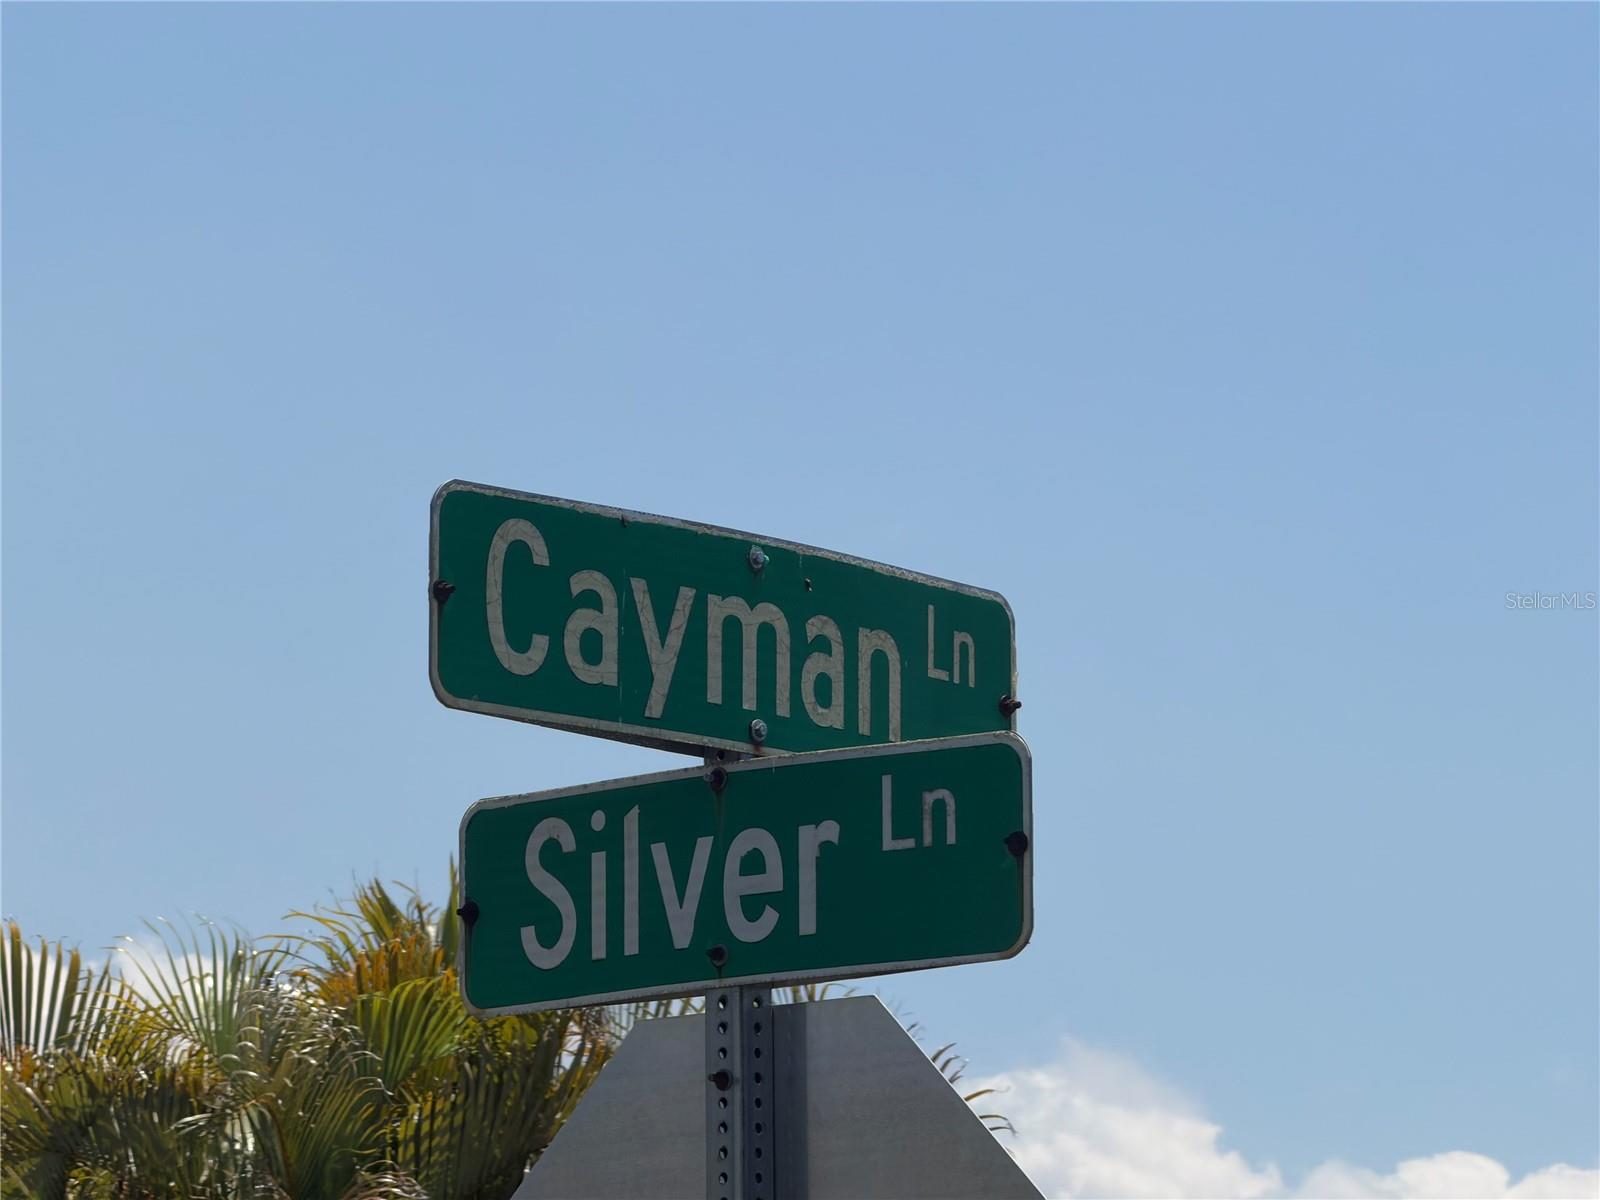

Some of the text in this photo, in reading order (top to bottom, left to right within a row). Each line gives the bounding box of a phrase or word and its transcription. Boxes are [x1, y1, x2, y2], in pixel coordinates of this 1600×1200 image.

[486, 518, 976, 743] Cayman Ln
[520, 774, 957, 971] Silver Ln
